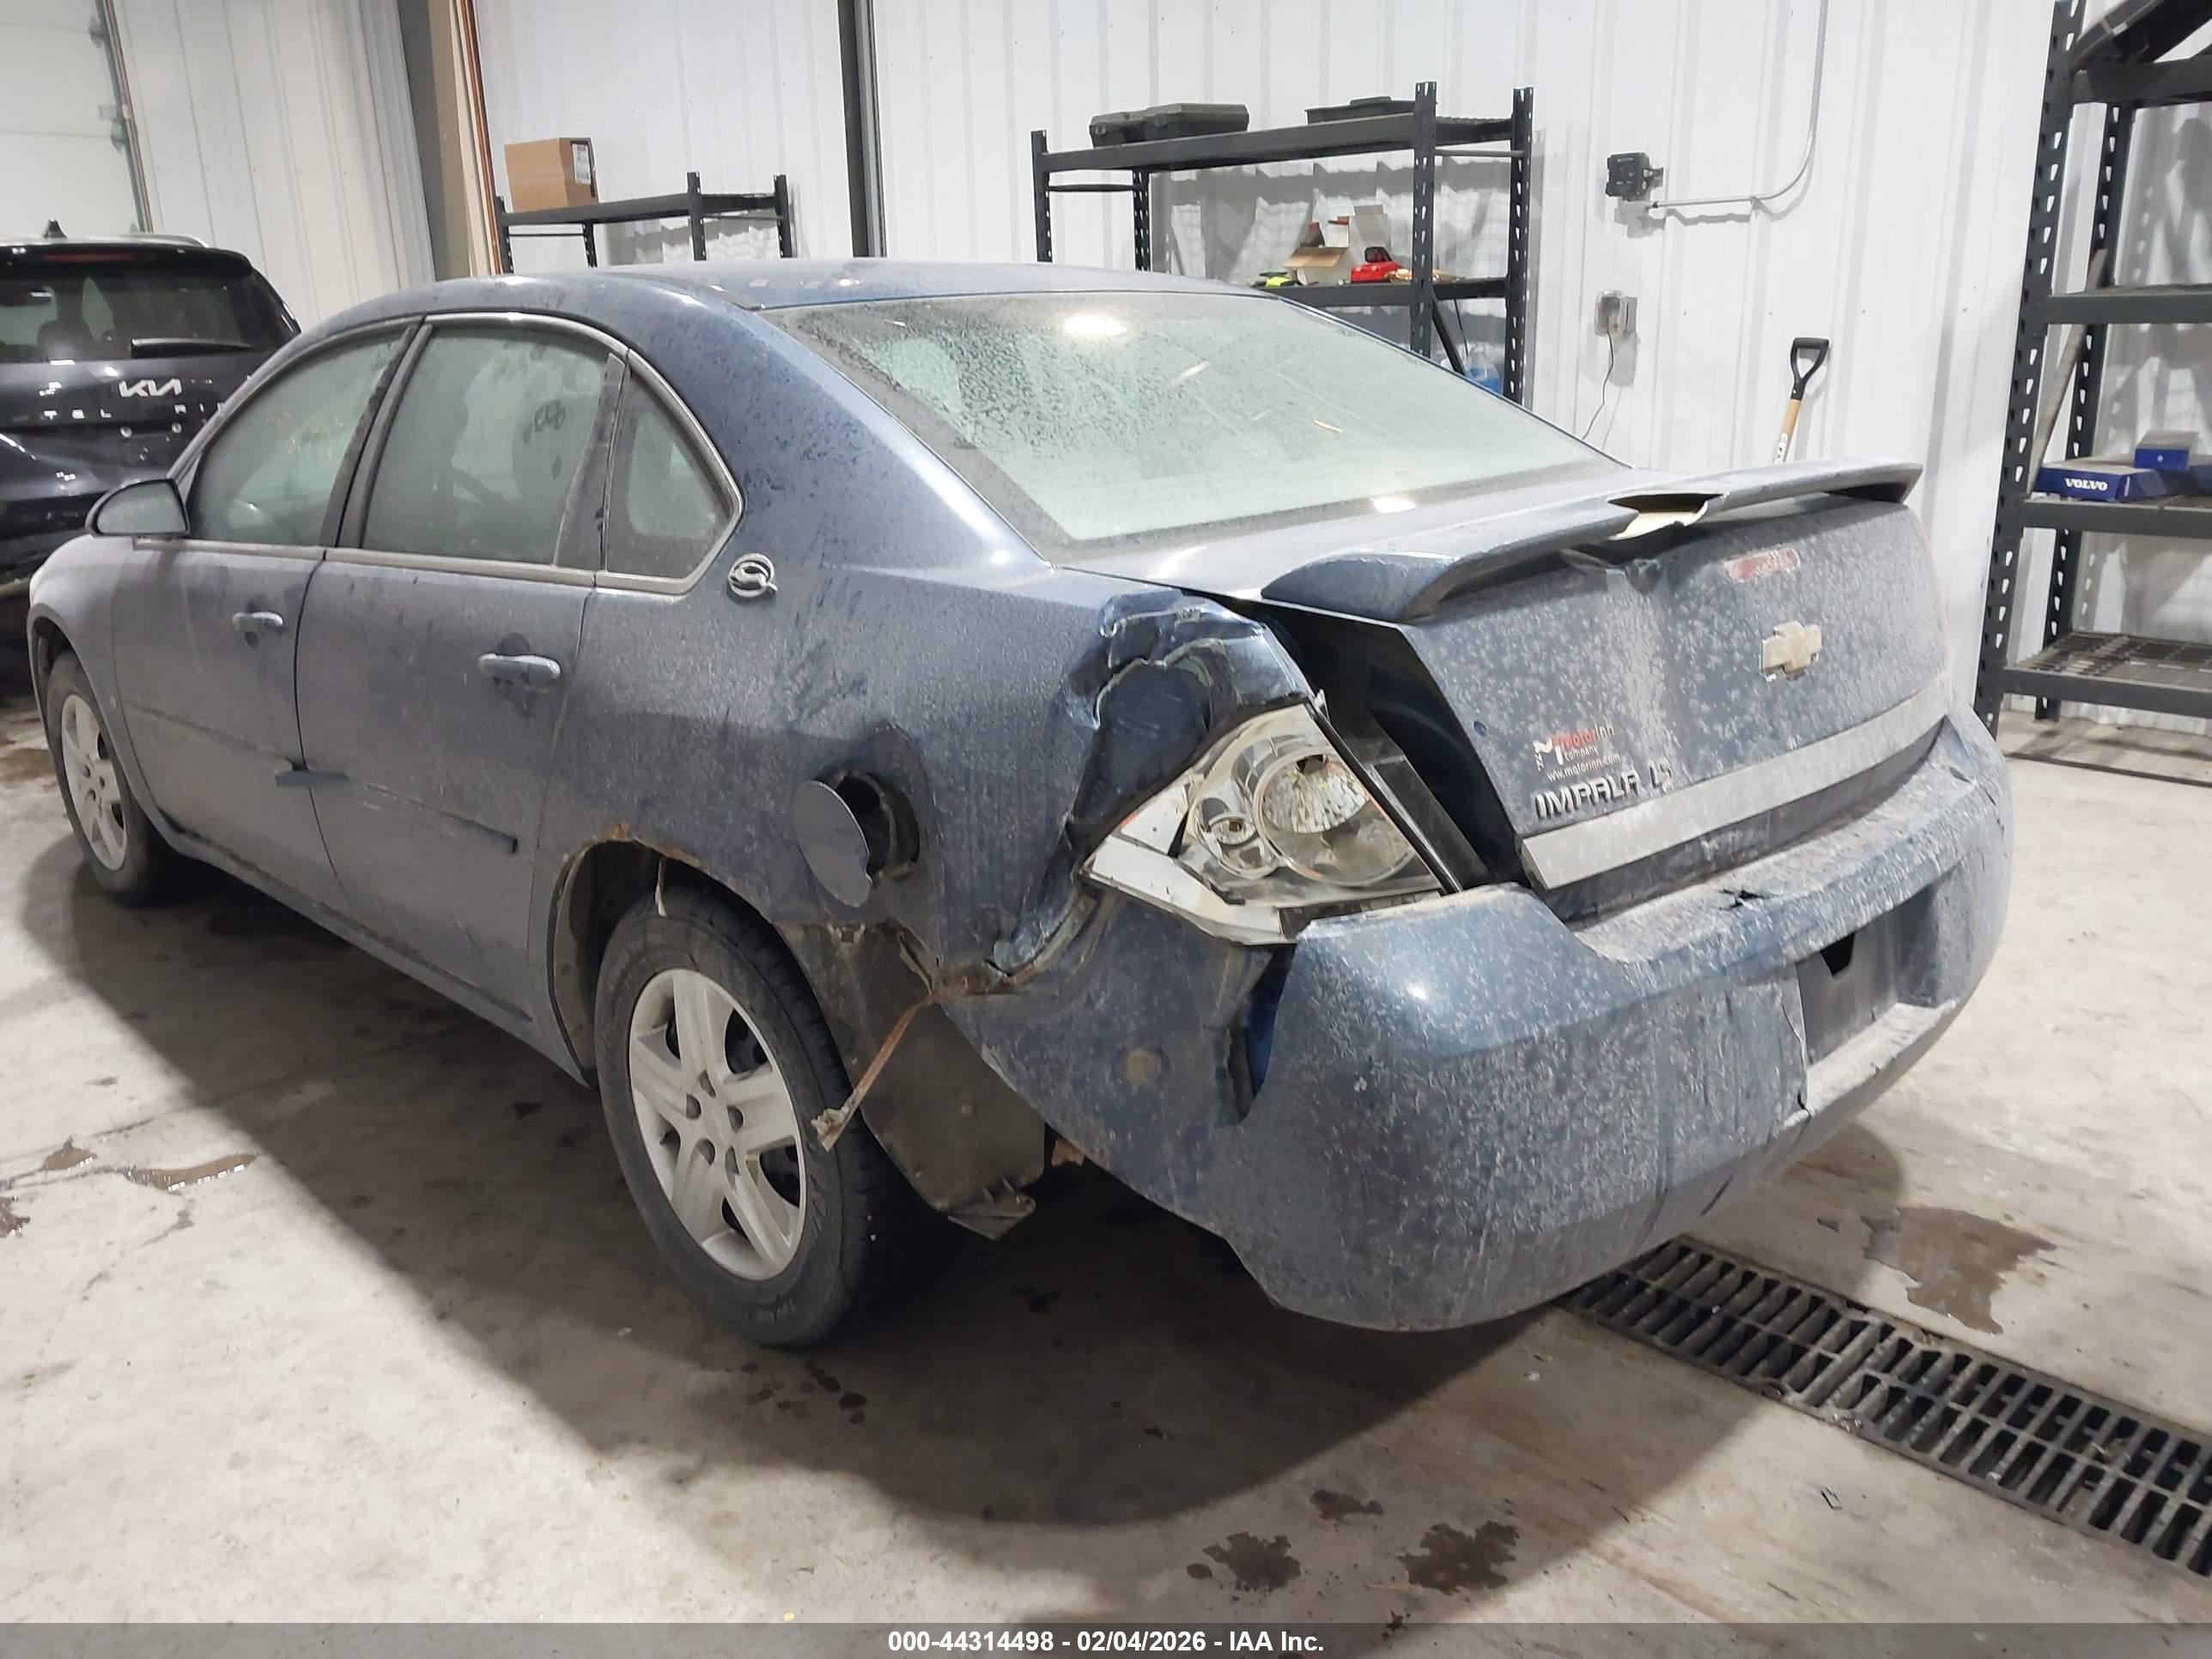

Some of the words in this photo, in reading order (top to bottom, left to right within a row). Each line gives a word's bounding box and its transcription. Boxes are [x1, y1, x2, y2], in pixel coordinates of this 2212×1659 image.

[119, 378, 182, 398] KIA
[2064, 477, 2108, 491] VOLVO
[1564, 744, 1598, 762] company
[1547, 753, 1621, 782] ww.motorinn.com
[1534, 769, 1640, 820] IMPALA
